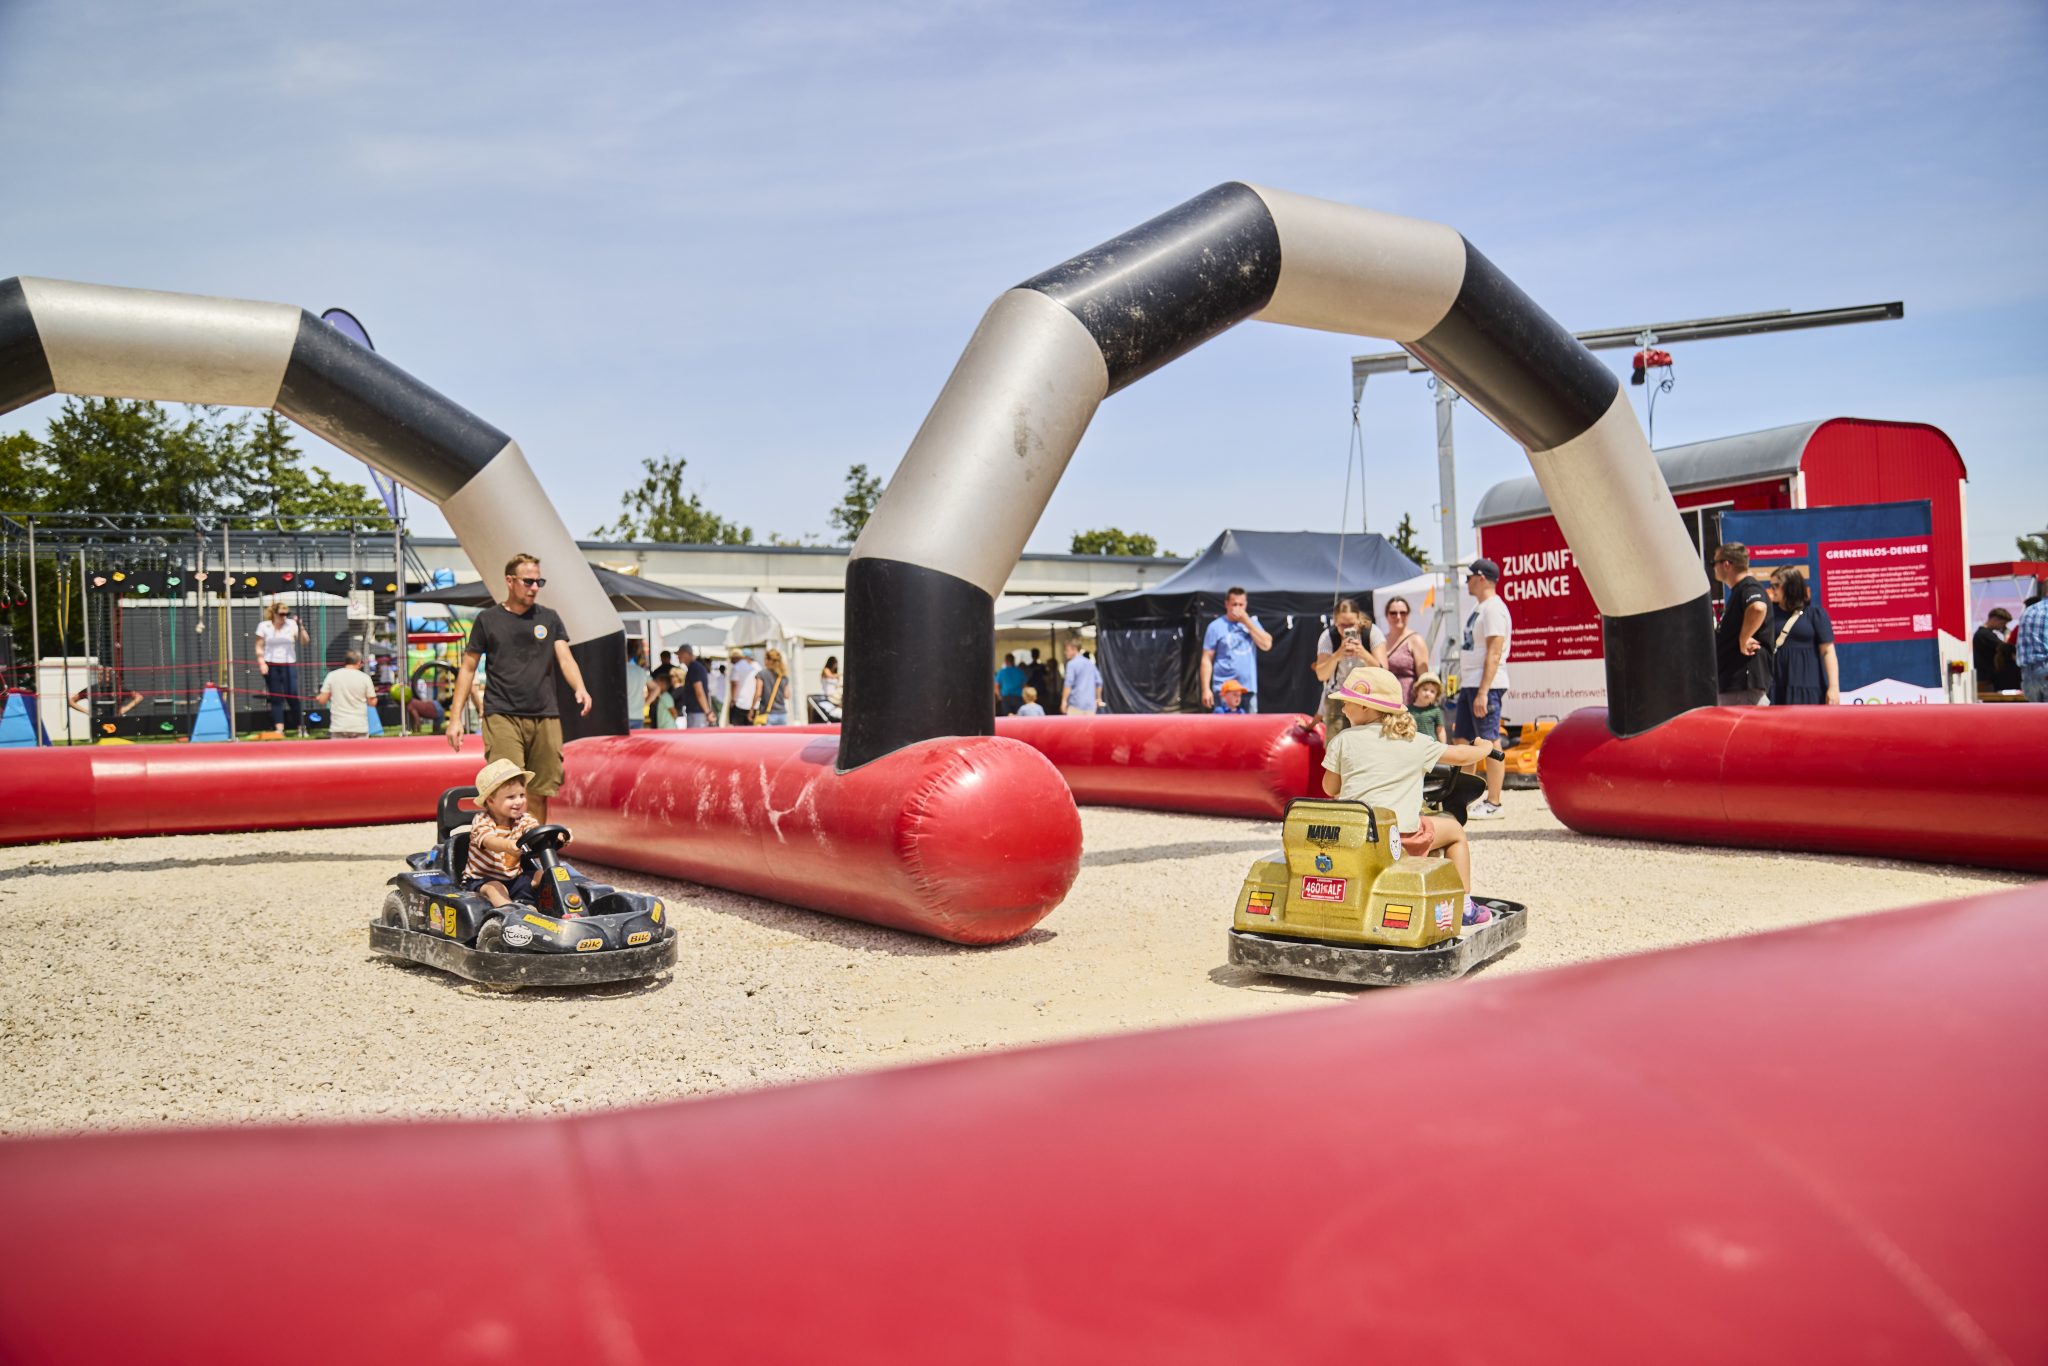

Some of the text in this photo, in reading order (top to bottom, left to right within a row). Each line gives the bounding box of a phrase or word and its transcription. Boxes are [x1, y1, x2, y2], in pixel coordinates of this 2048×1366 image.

[1826, 544, 1928, 559] GRENZENLOS-DENKER
[1504, 575, 1570, 602] CHANCE
[1307, 825, 1341, 840] NAVAIR
